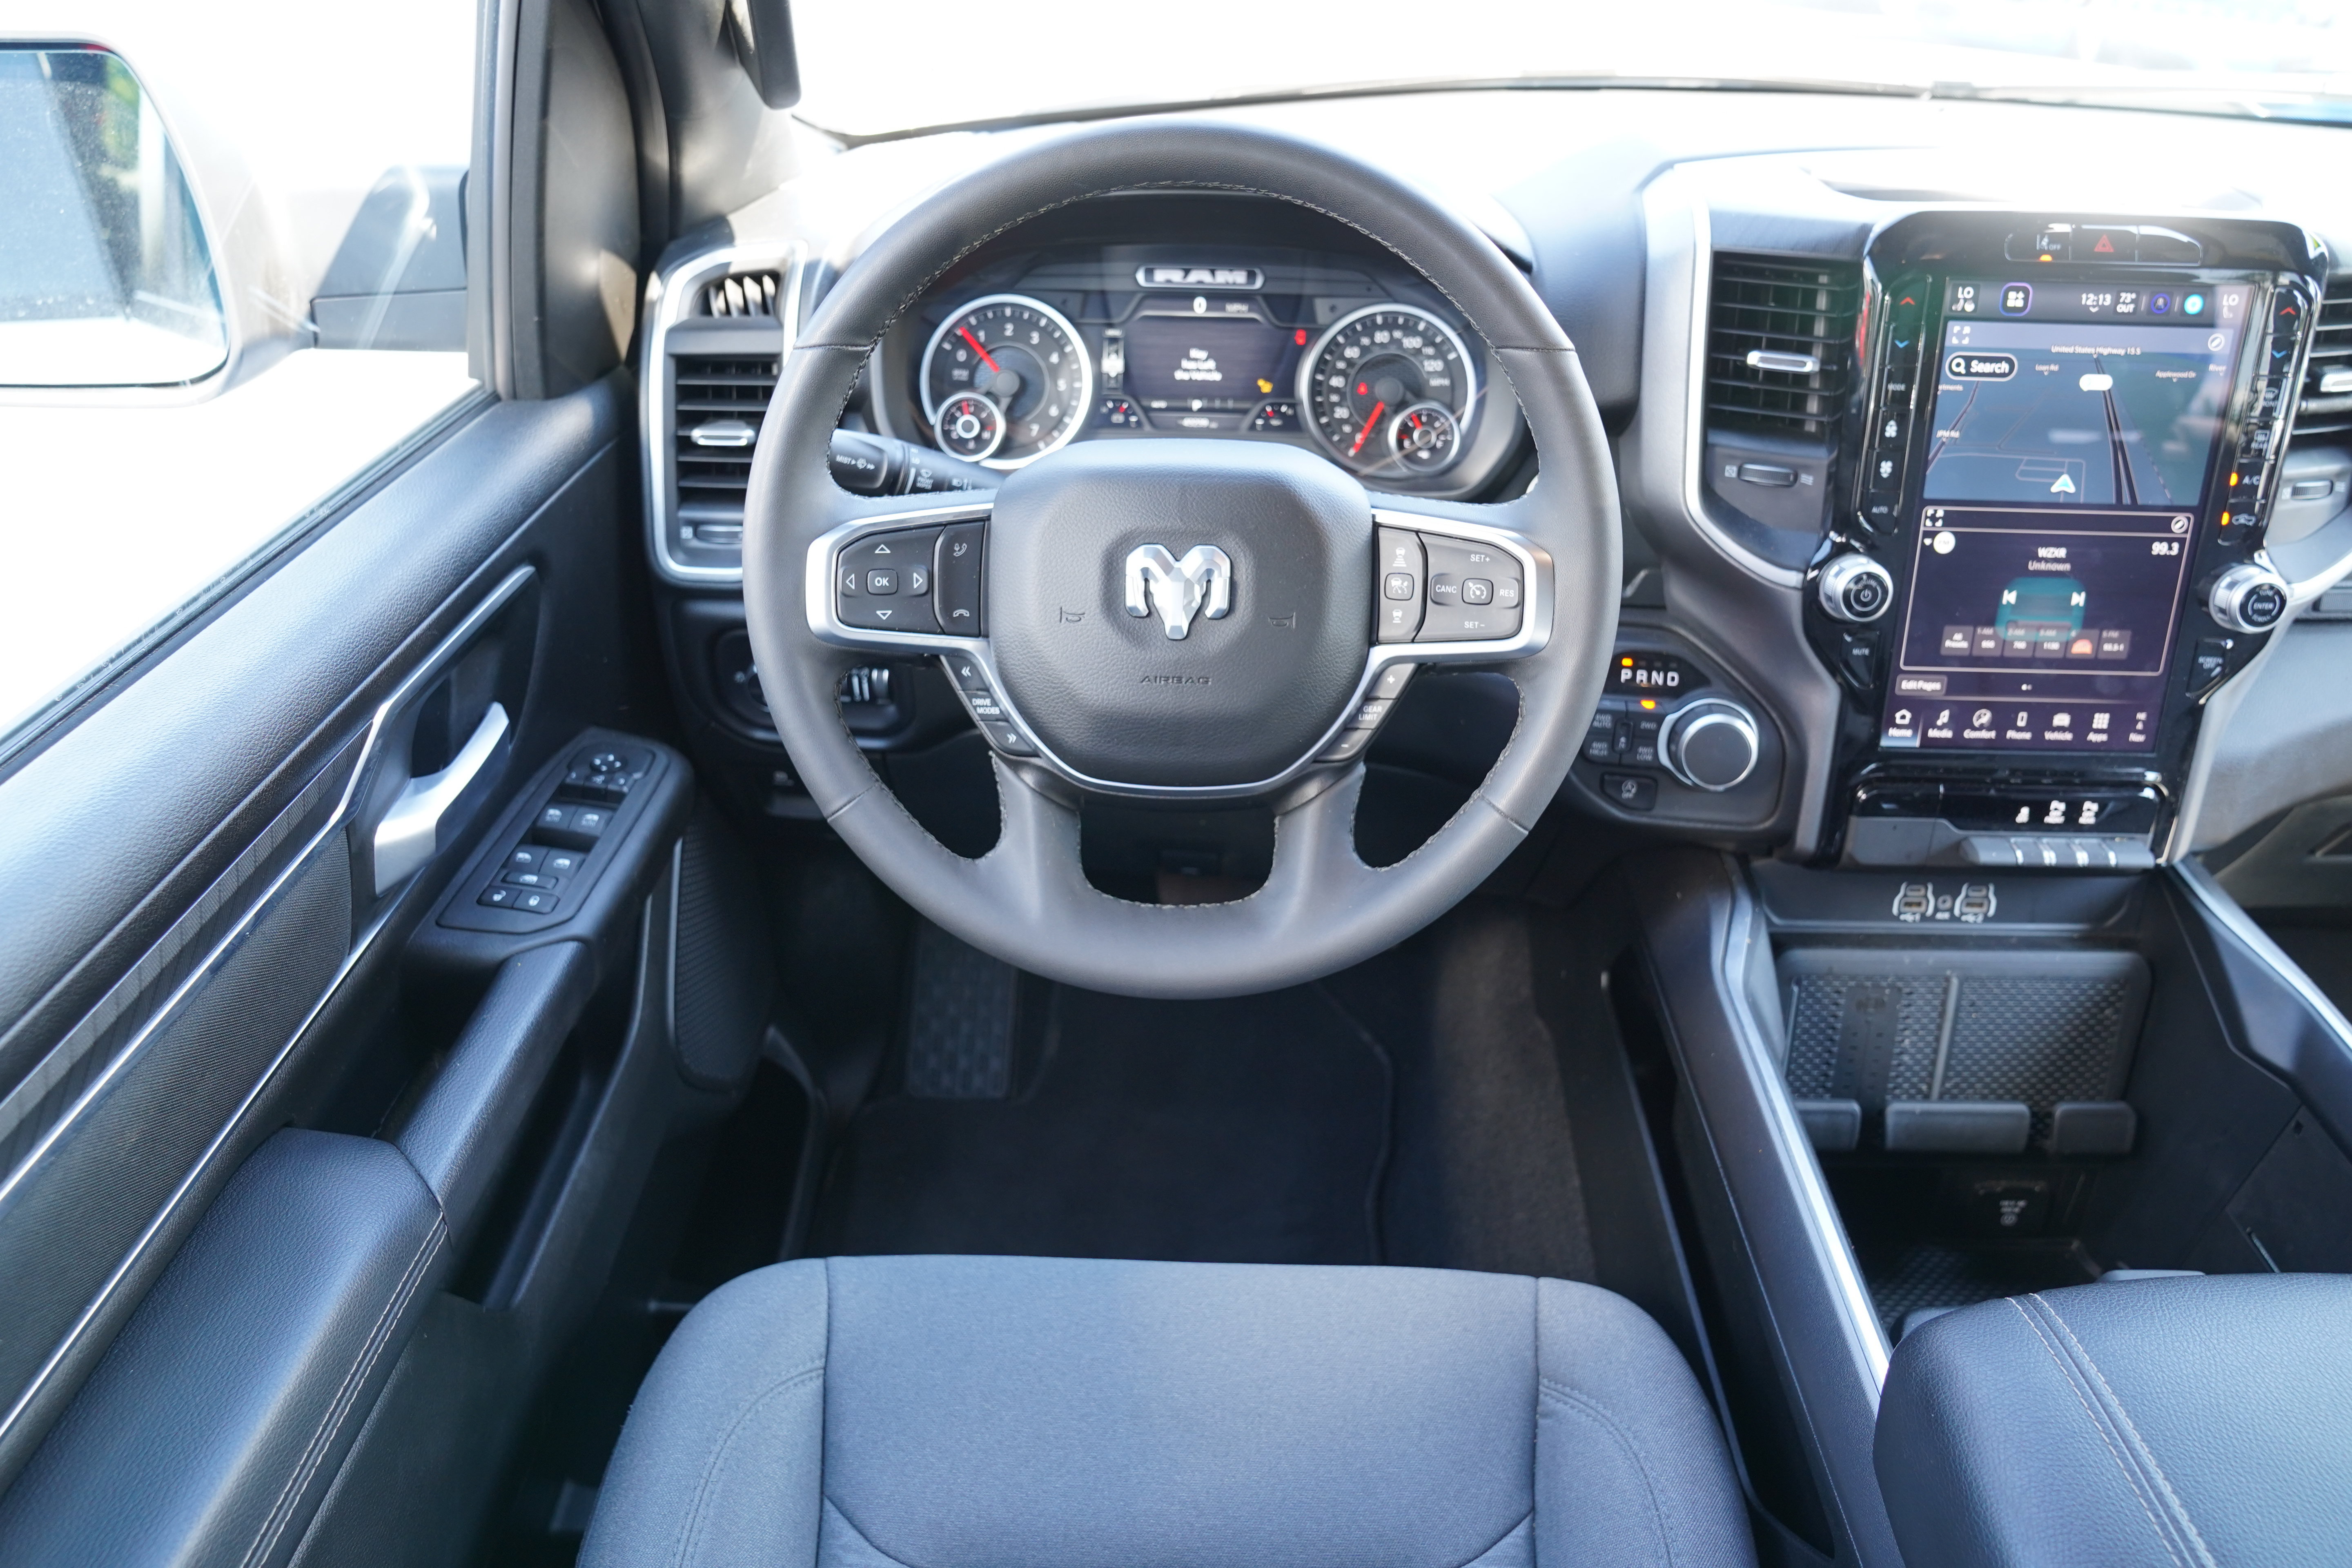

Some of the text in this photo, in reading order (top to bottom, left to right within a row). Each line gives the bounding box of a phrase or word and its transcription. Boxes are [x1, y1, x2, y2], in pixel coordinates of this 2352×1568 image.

[1153, 269, 1247, 285] RAM
[1958, 286, 1974, 298] LO
[1193, 296, 1207, 314] 0
[2081, 293, 2111, 306] 12:13
[2223, 294, 2239, 306] LO
[2116, 303, 2136, 313] OUT
[1004, 323, 1014, 336] 2
[977, 329, 985, 343] 1
[1029, 331, 1040, 344] 3
[1374, 330, 1390, 343] 80
[1401, 336, 1423, 348] 100
[2051, 345, 2074, 353] United
[2074, 345, 2095, 354] States
[2096, 346, 2125, 356] Highway
[1049, 351, 1059, 364] 4
[1423, 359, 1444, 372] 120
[1970, 360, 2009, 374] Search
[2209, 363, 2226, 372] River
[2156, 370, 2188, 379] Applewood
[1057, 378, 1067, 391] 5
[1329, 375, 1345, 388] 40
[1429, 377, 1450, 387] MPH
[1048, 403, 1059, 417] 6
[1333, 406, 1350, 419] 20
[1029, 423, 1040, 437] 7
[836, 454, 851, 465] MIST
[2242, 475, 2261, 486] A/C
[2038, 547, 2067, 559] WZXR
[2152, 541, 2179, 556] 99.3
[2028, 560, 2071, 572] Unknown
[874, 577, 889, 586] OK
[1855, 578, 1878, 588] VOLUME
[1436, 585, 1457, 593] CANC
[1500, 588, 1514, 597] RES
[2253, 602, 2274, 610] ENTER
[1852, 648, 1870, 656] MUTE
[2198, 656, 2223, 664] SCREEN
[1140, 675, 1212, 685] AIRBAG
[1901, 679, 1942, 692] Edit Pages
[972, 698, 991, 706] DRIVE
[976, 707, 1000, 715] MODES
[1363, 705, 1382, 713] GEAR
[1358, 713, 1378, 721] LIMIT
[1595, 713, 1613, 722] 4WD
[1592, 720, 1613, 729] AUTO
[1640, 720, 1658, 730] 2WD
[1888, 727, 1913, 738] Home
[1927, 728, 1953, 739] Media
[1963, 728, 1997, 739] Comfort
[2006, 729, 2032, 740] Phone
[2044, 731, 2073, 741] Vehicle
[2087, 731, 2108, 743] Apps
[2129, 732, 2146, 742] Nav
